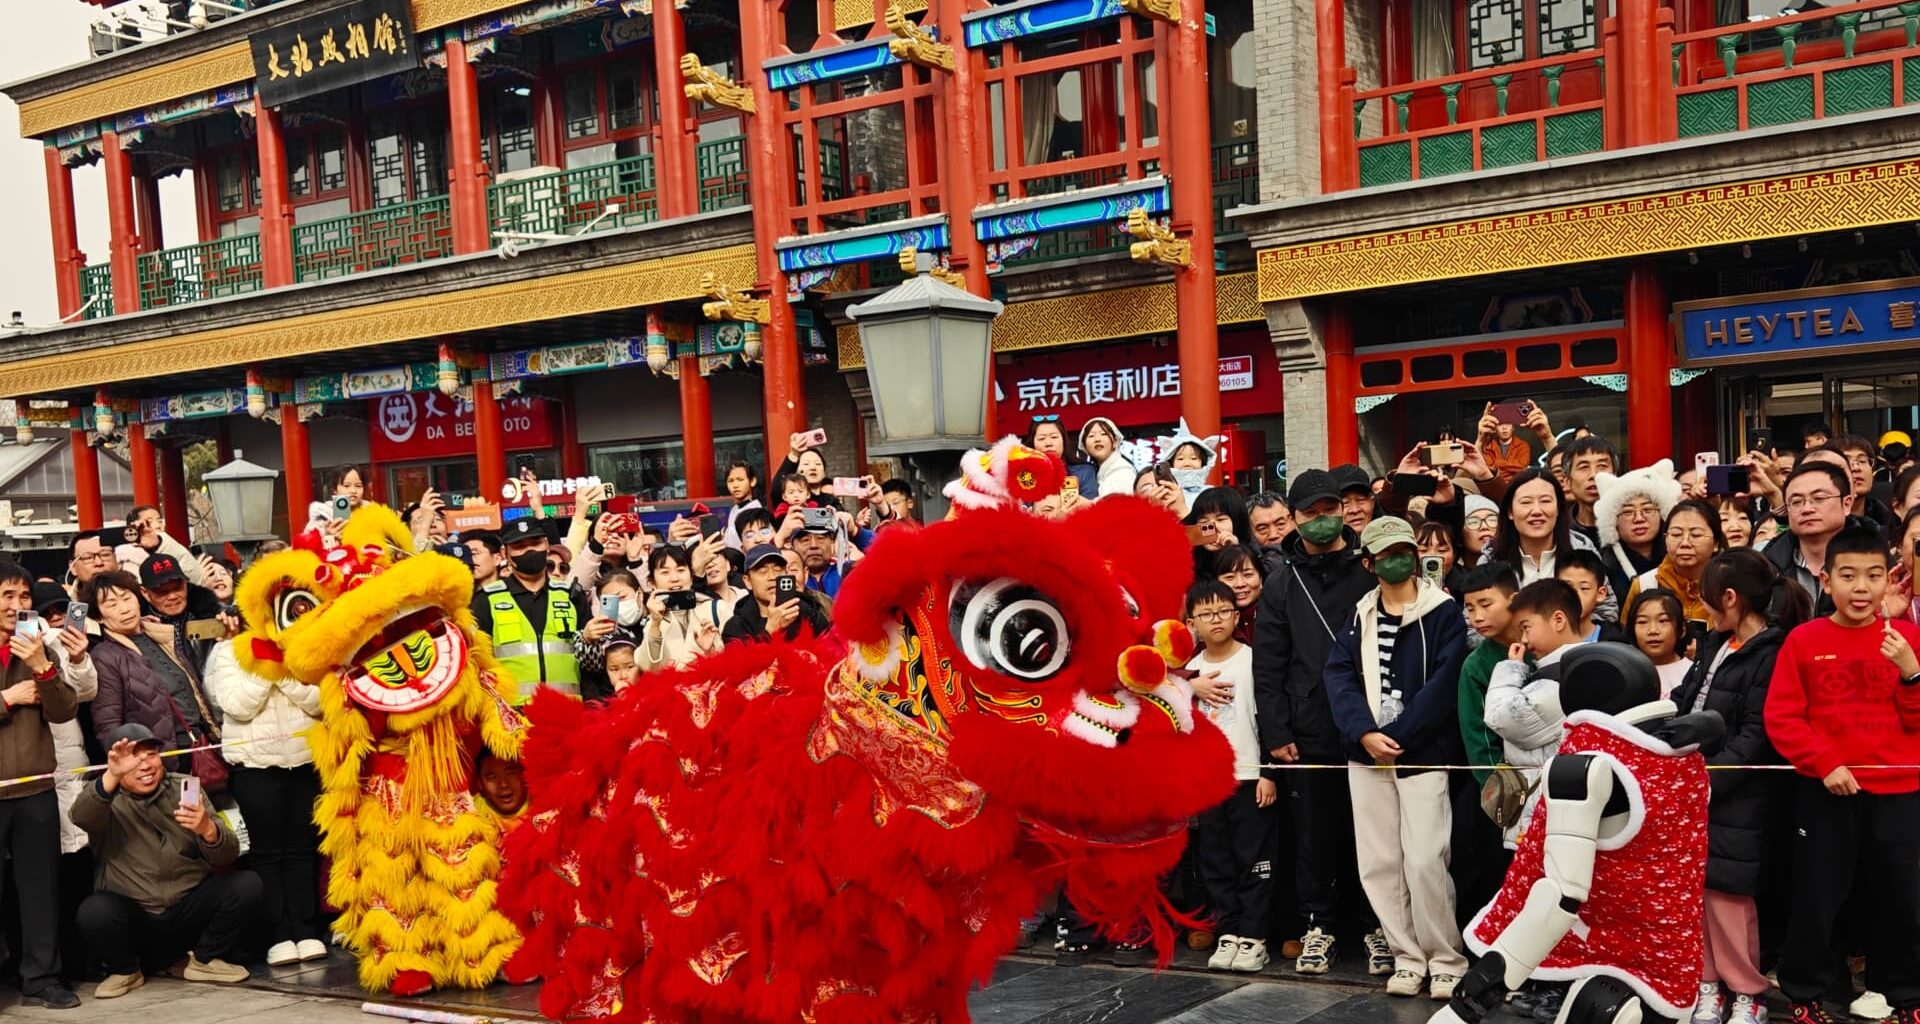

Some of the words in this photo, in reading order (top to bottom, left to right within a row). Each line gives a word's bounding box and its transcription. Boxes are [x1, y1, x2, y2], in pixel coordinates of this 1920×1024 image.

[1704, 306, 1865, 347] HEYTEA
[1888, 301, 1920, 328] 喜
[1017, 364, 1180, 411] 京东便利店
[427, 425, 445, 440] DA
